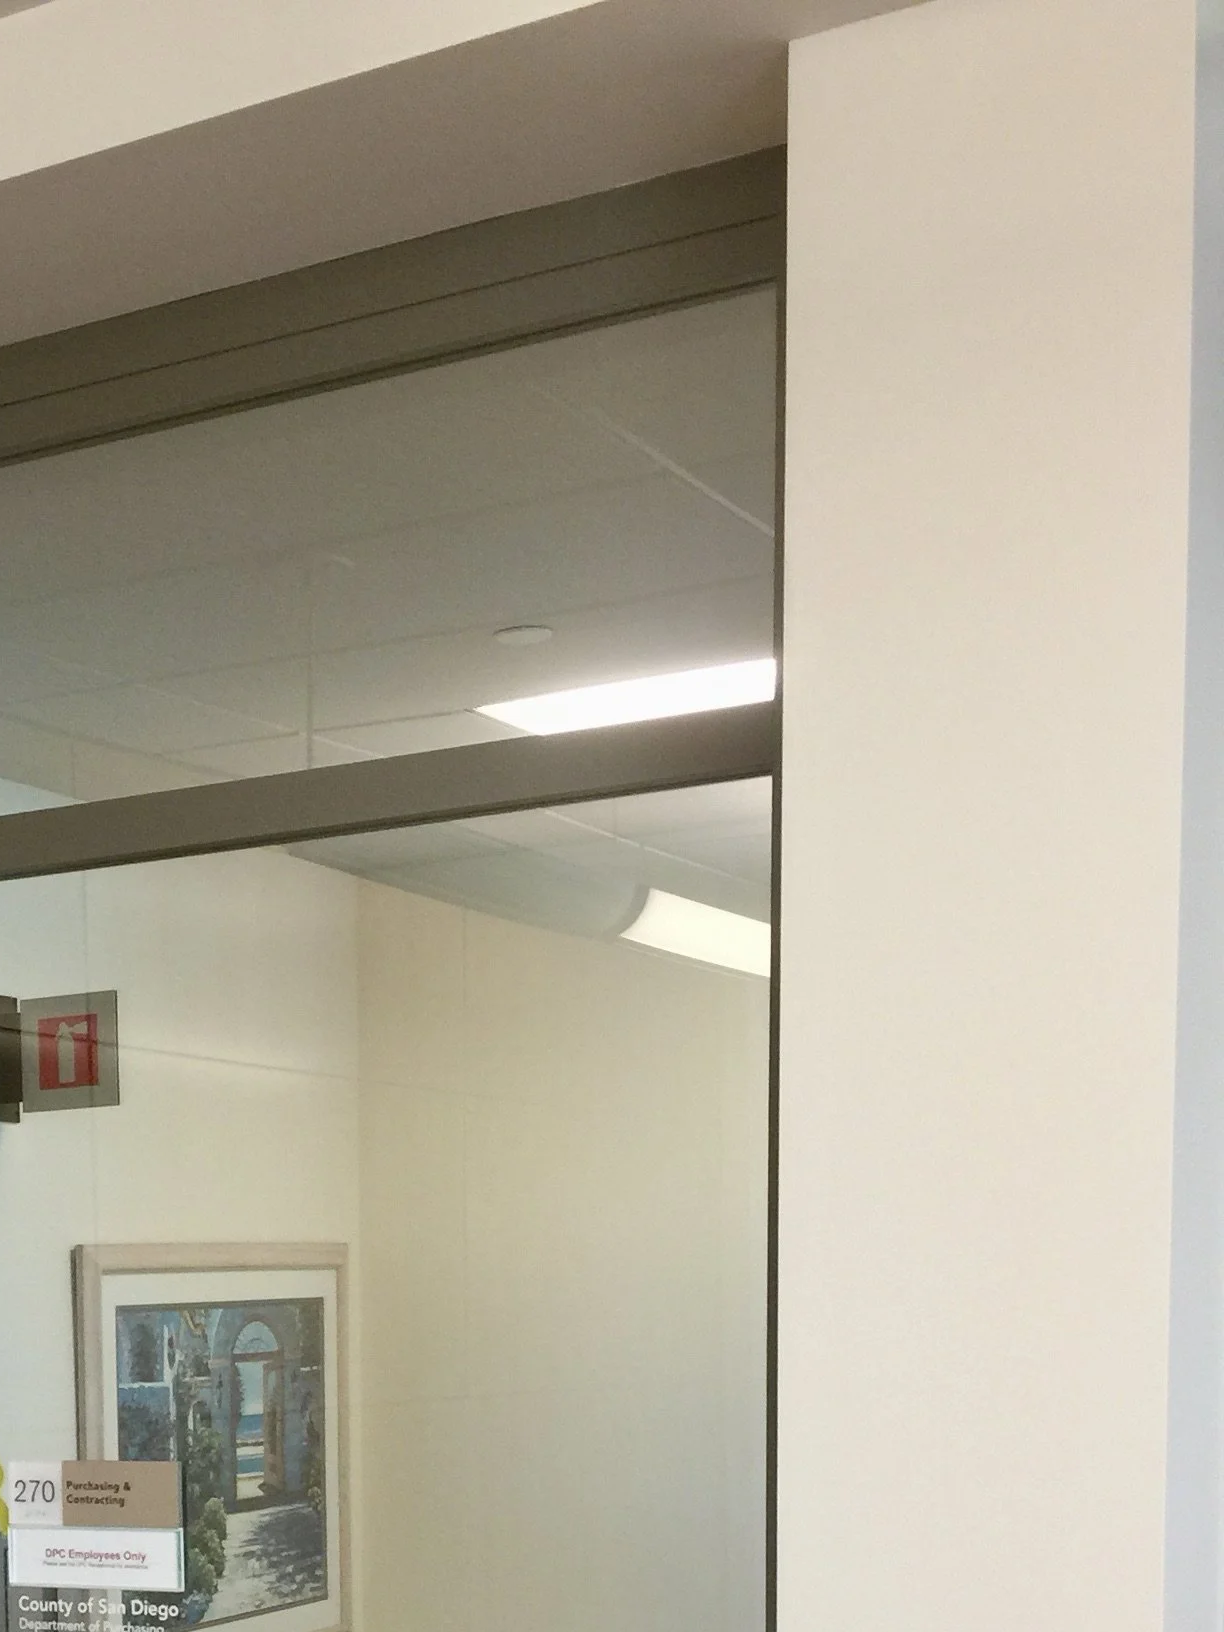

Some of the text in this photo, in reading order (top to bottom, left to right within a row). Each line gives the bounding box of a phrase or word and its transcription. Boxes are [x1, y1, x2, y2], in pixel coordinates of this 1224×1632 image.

[14, 1480, 55, 1503] 270
[66, 1481, 131, 1494] Purchasing &
[66, 1494, 125, 1508] Contracting
[45, 1548, 146, 1564] DPC Employees Only
[18, 1596, 179, 1621] County of San Diego
[19, 1617, 85, 1632] Department
[88, 1620, 101, 1632] of
